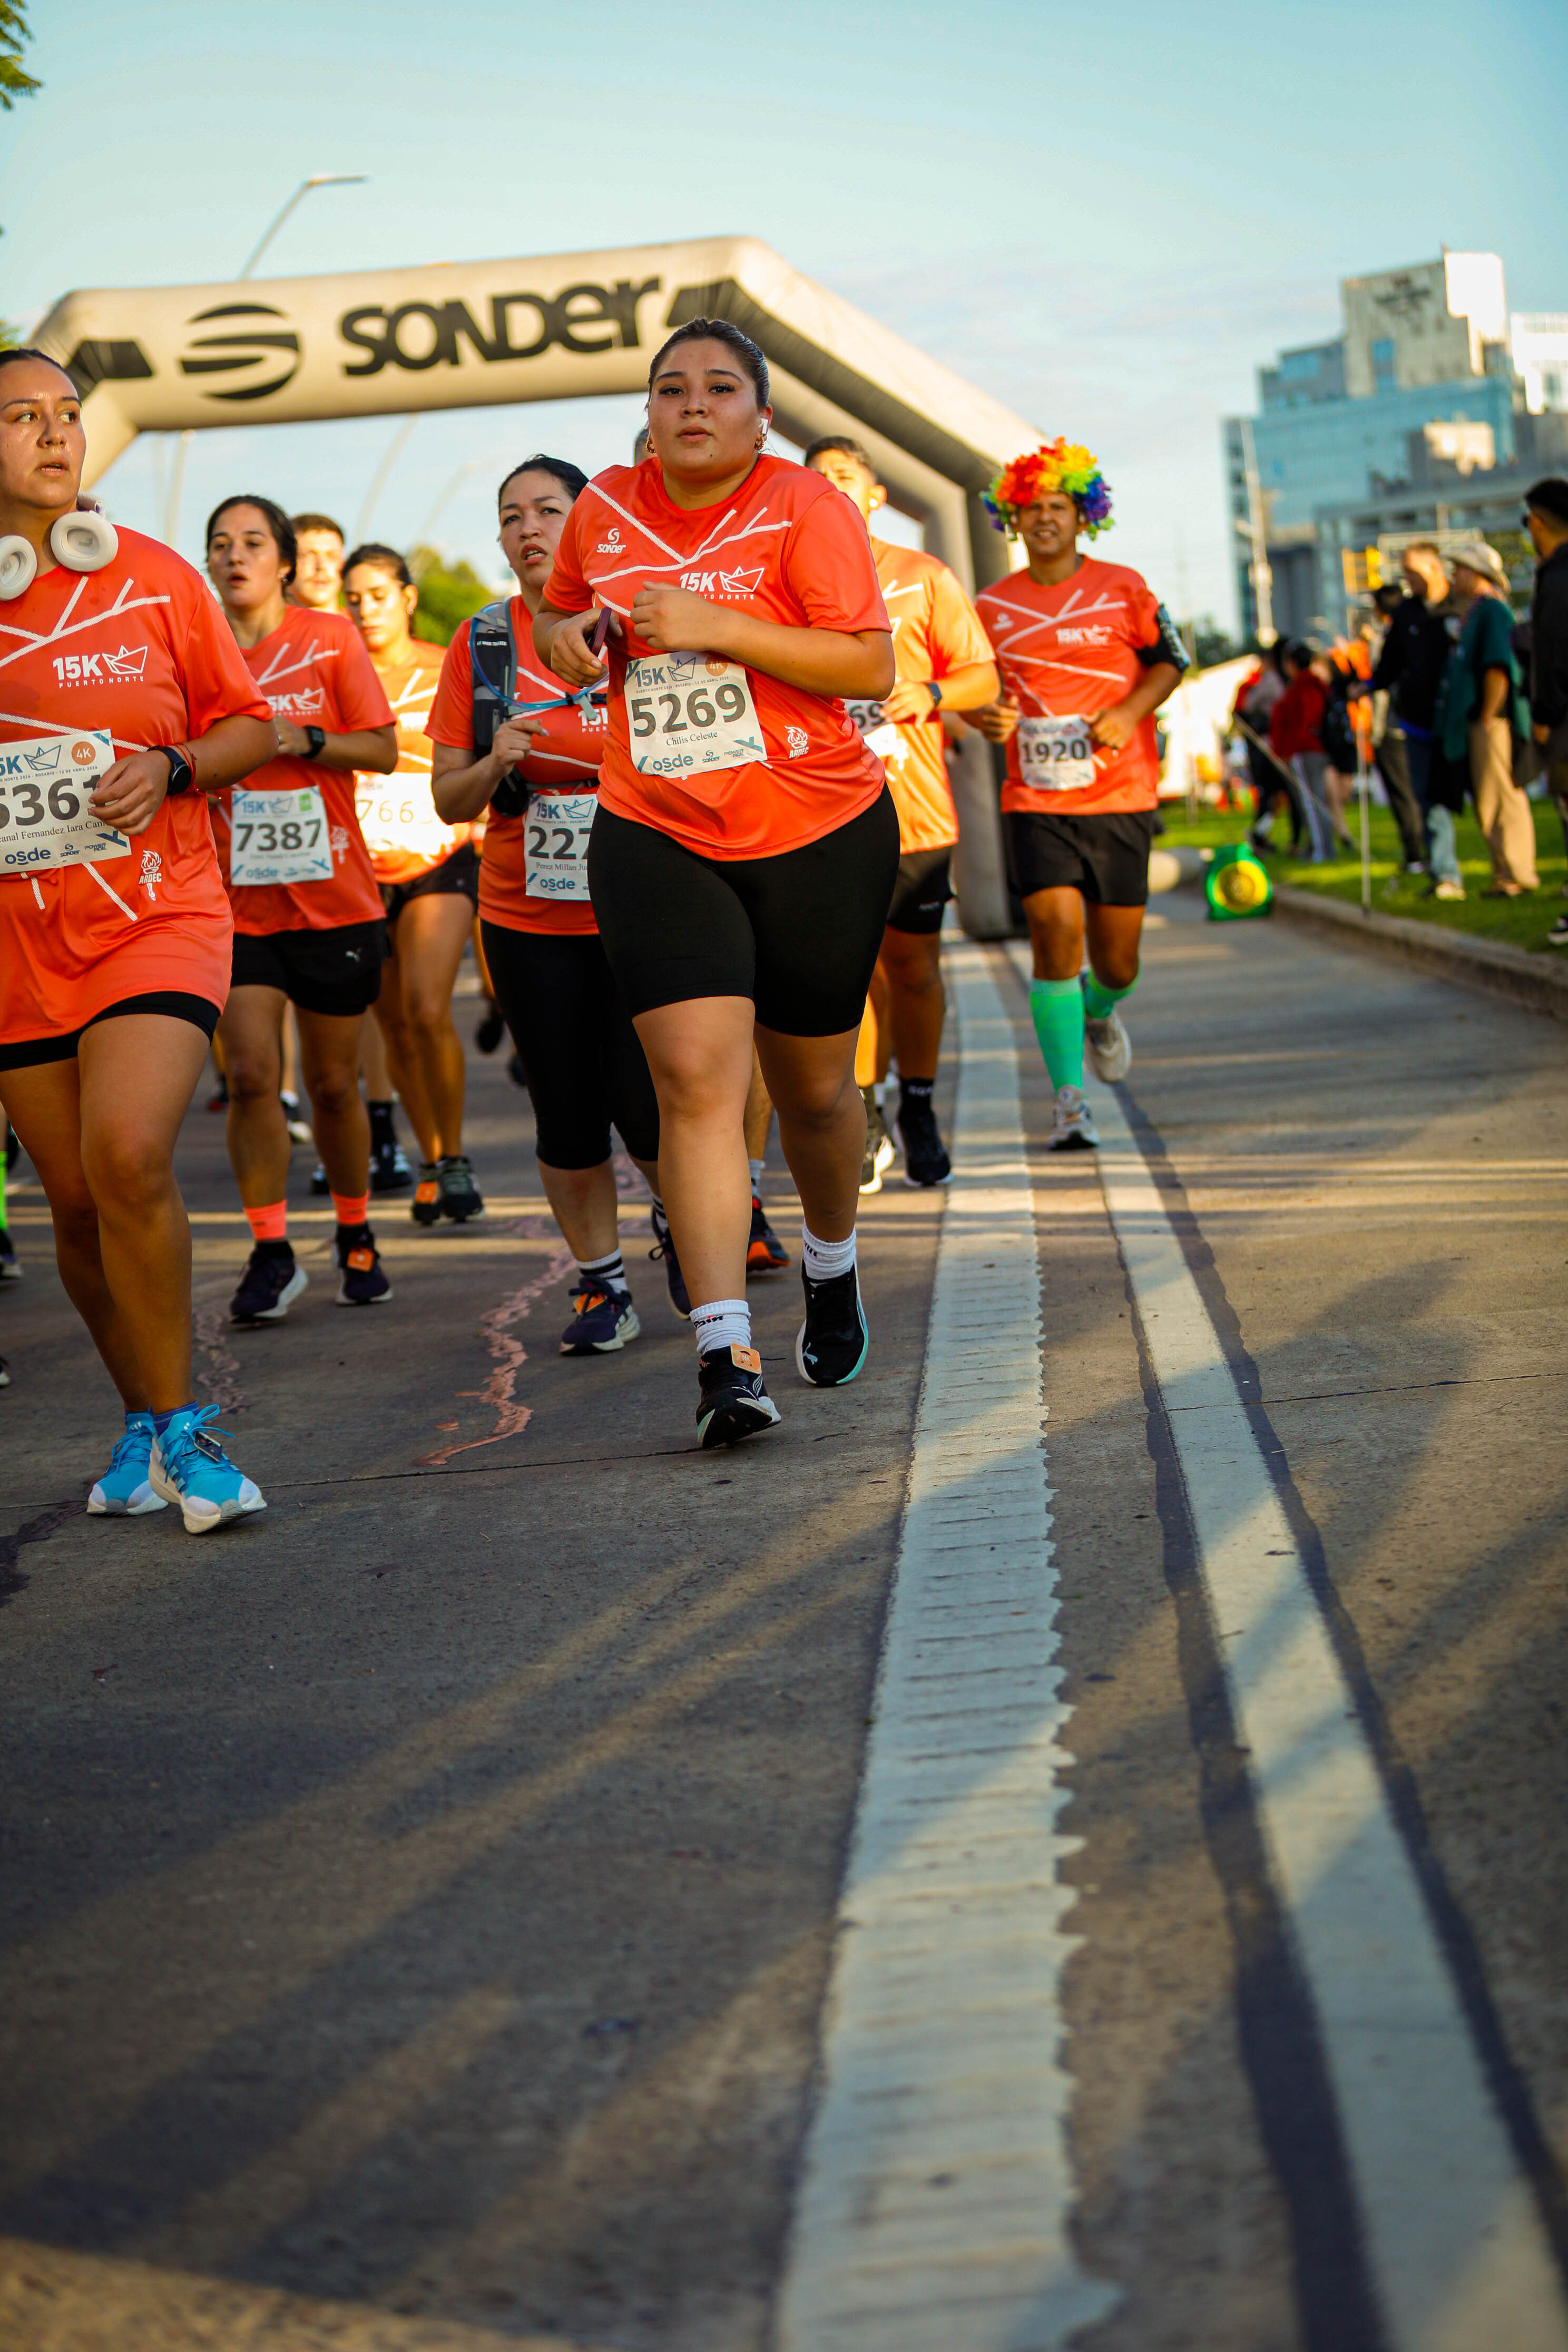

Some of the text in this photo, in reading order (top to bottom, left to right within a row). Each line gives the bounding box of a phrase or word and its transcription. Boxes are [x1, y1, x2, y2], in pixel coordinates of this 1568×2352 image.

[680, 572, 718, 592] 15K
[53, 654, 103, 680] 15K
[709, 660, 723, 671] 4K
[59, 679, 104, 689] PUERTO
[635, 667, 667, 688] 15K
[631, 683, 746, 738] 5269
[666, 731, 718, 746] Chilis Celeste
[76, 747, 92, 759] 4K
[789, 747, 809, 759] ARDEC
[1023, 739, 1086, 763] 1920
[652, 753, 694, 772] osde
[242, 800, 265, 813] 15K
[536, 802, 561, 818] 15K
[21, 828, 65, 839] Fernandez
[66, 825, 83, 833] Iara
[236, 818, 321, 851] 7387
[5, 847, 51, 865] osde
[139, 873, 162, 884] ARDEC
[540, 878, 575, 891] osde
